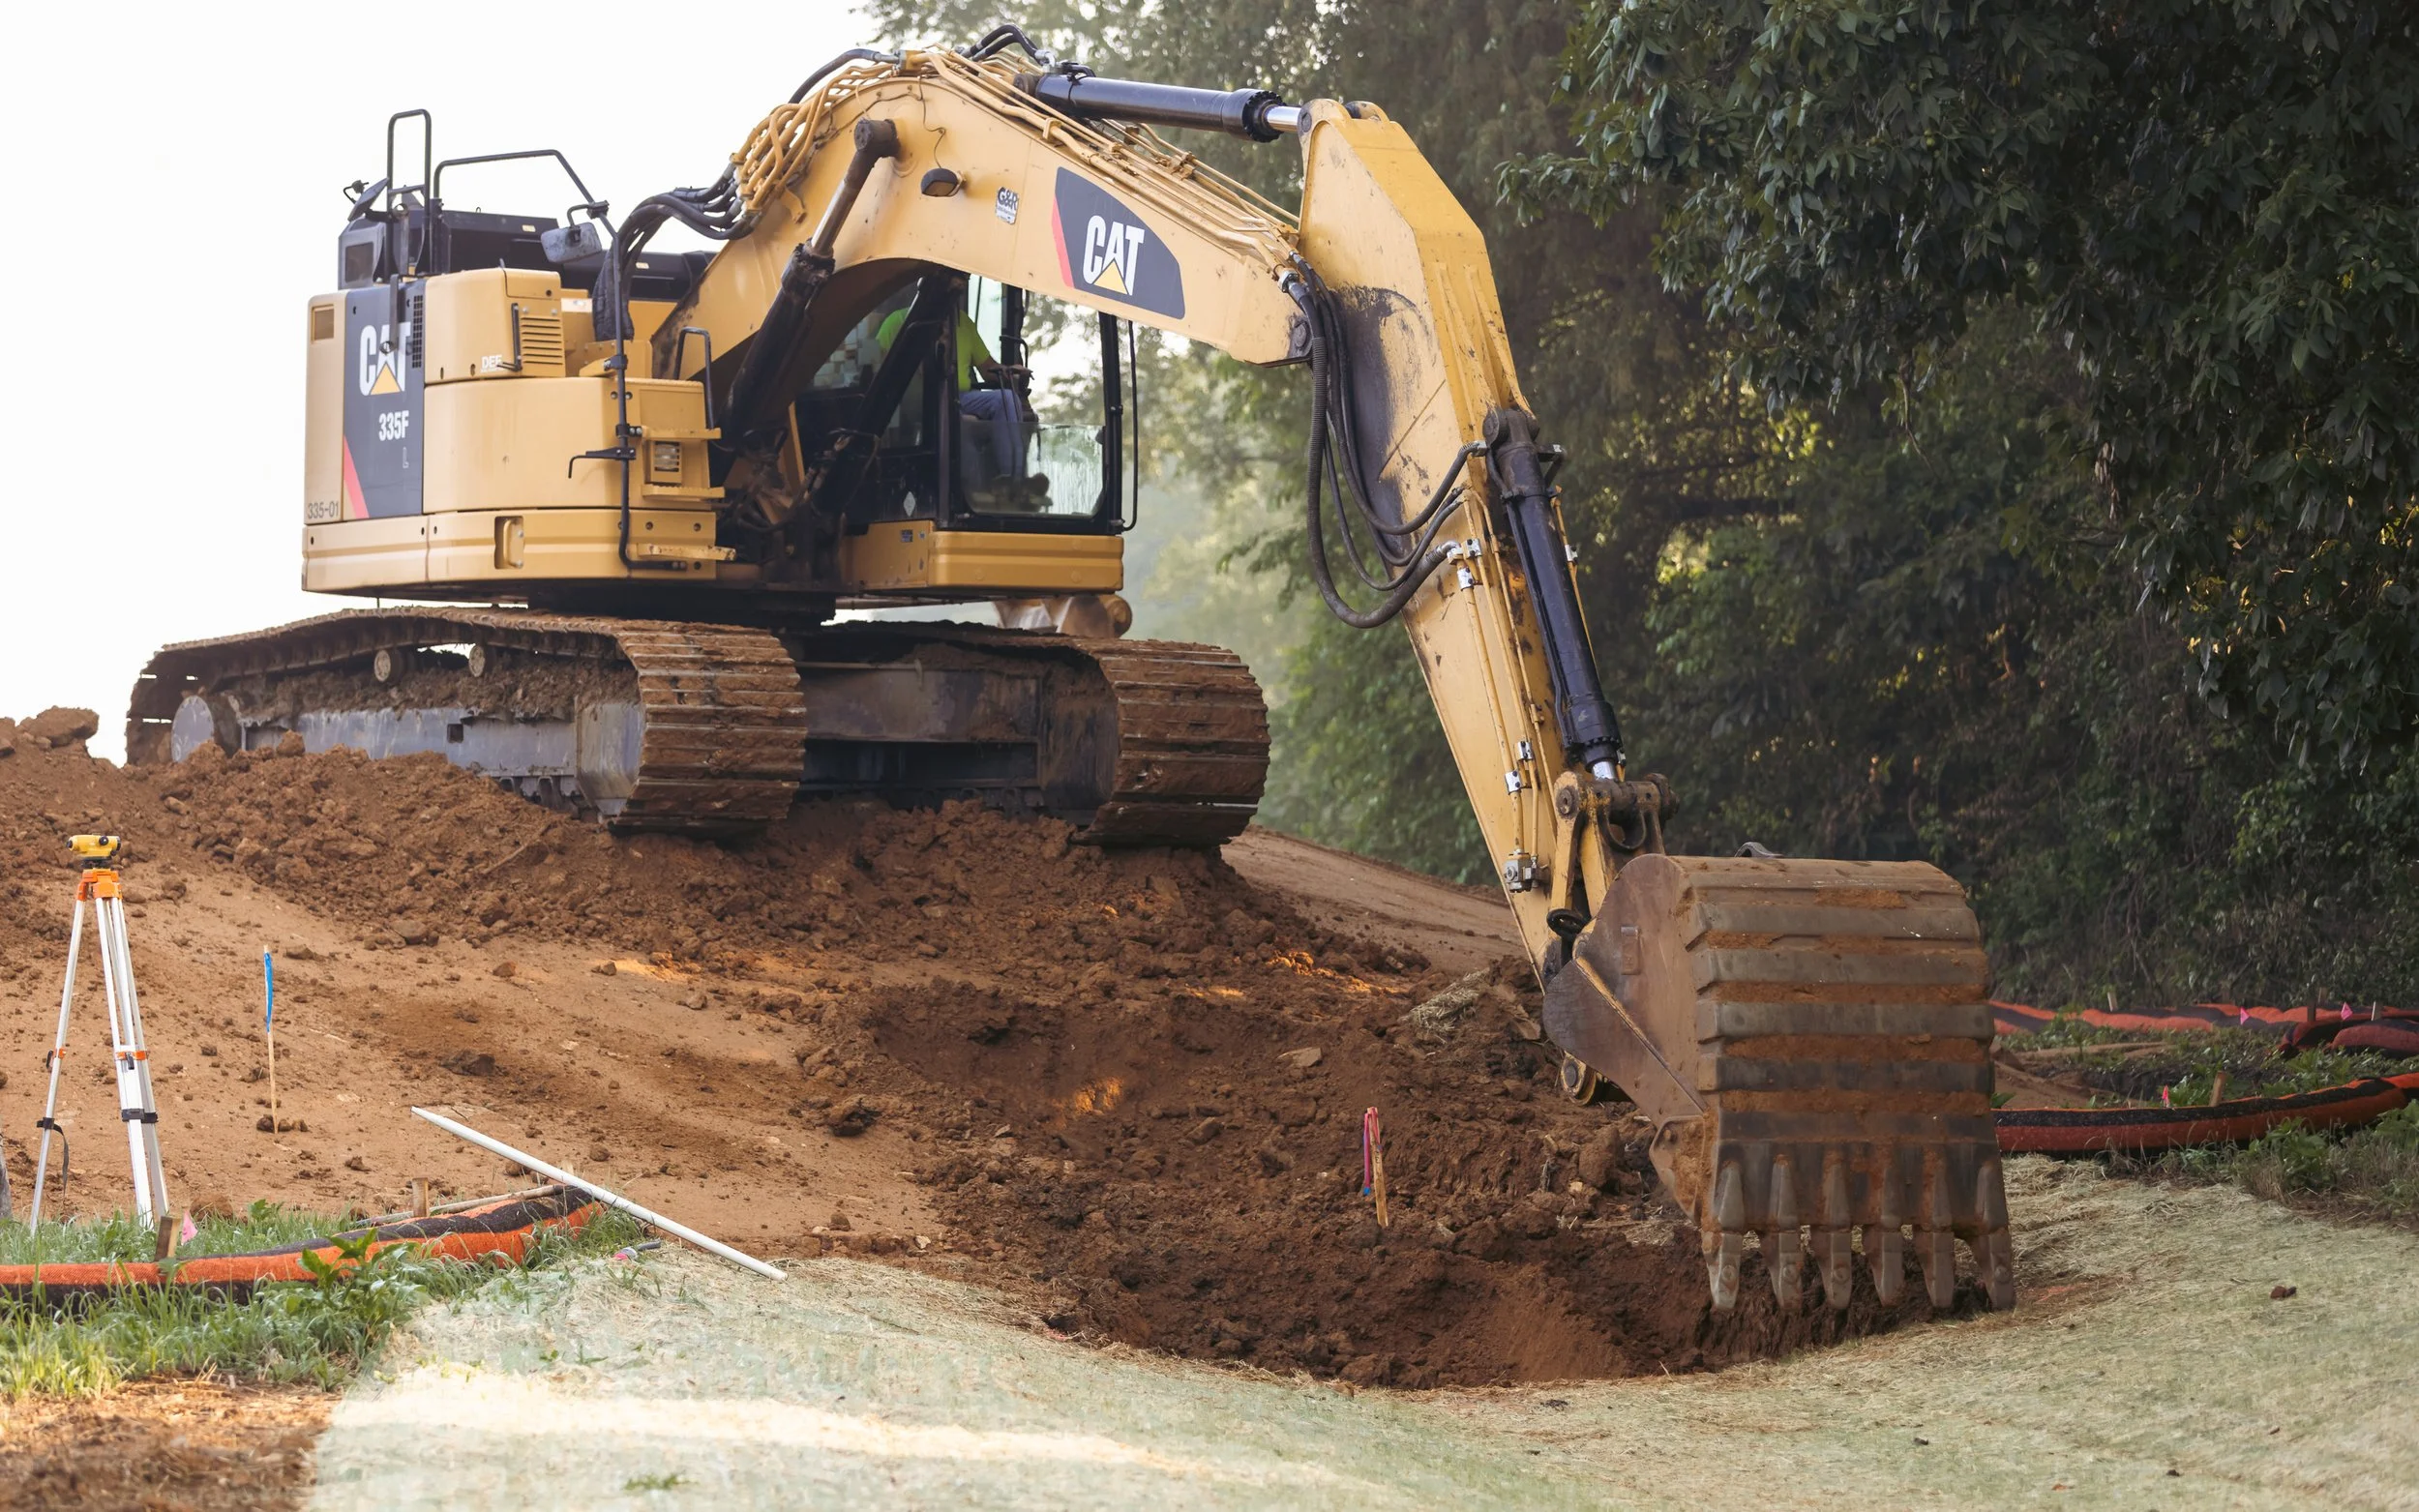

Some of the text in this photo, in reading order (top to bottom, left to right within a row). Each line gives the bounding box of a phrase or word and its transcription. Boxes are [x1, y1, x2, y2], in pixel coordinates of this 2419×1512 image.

[998, 187, 1019, 210] G&R
[1083, 215, 1145, 296] CAT
[359, 321, 411, 397] CAT
[378, 410, 409, 441] 335F
[308, 501, 339, 519] 335-01
